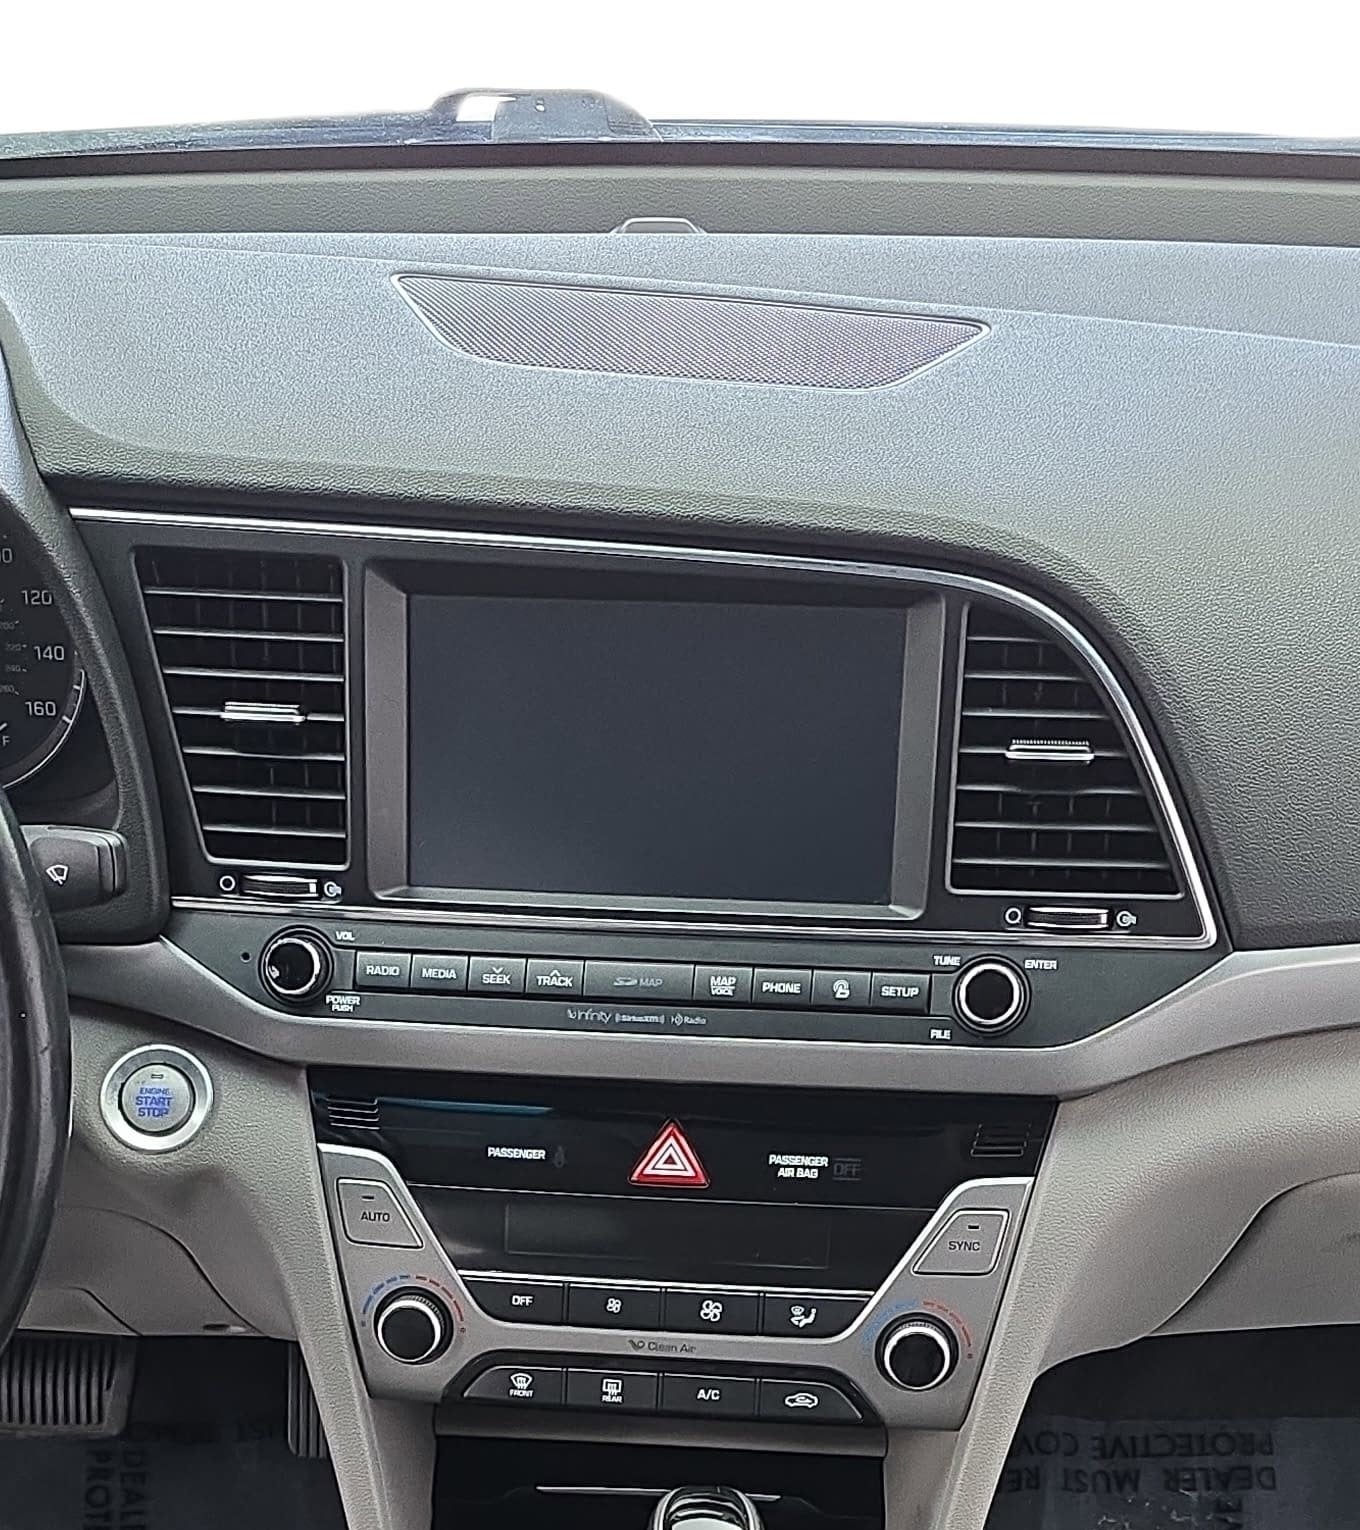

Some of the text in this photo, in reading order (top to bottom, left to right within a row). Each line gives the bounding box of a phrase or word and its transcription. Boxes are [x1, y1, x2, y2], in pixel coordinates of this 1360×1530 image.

[21, 590, 52, 605] 120
[34, 646, 64, 661] 140
[25, 701, 56, 716] 160
[2, 735, 11, 747] F
[336, 931, 355, 941] VOL
[933, 956, 960, 966] TUNE
[1024, 960, 1057, 970] ENTER
[366, 965, 400, 976] RADIO
[422, 968, 456, 980] MEDIA
[482, 973, 511, 985] SEEK
[537, 976, 573, 988] TRACK
[710, 976, 736, 987] MAP
[711, 987, 735, 996] VOICE
[762, 982, 801, 994] PHONE
[881, 986, 919, 998] SETUP
[326, 996, 360, 1005] POWER
[332, 1004, 353, 1012] PUSH
[930, 1029, 951, 1039] FILE
[140, 1087, 170, 1096] ENGINE
[135, 1096, 172, 1107] START
[138, 1106, 169, 1118] STOP
[487, 1147, 546, 1160] PASSENGER
[769, 1155, 828, 1168] PASSENGER
[778, 1167, 818, 1179] AIR BAG
[833, 1162, 861, 1177] OFF
[361, 1211, 390, 1222] AUTO
[948, 1240, 980, 1251] SYNC
[512, 1295, 533, 1306] OFF
[648, 1342, 677, 1353] Clean
[510, 1389, 533, 1398] FRONT
[602, 1395, 622, 1403] REAR
[697, 1389, 720, 1400] A/C
